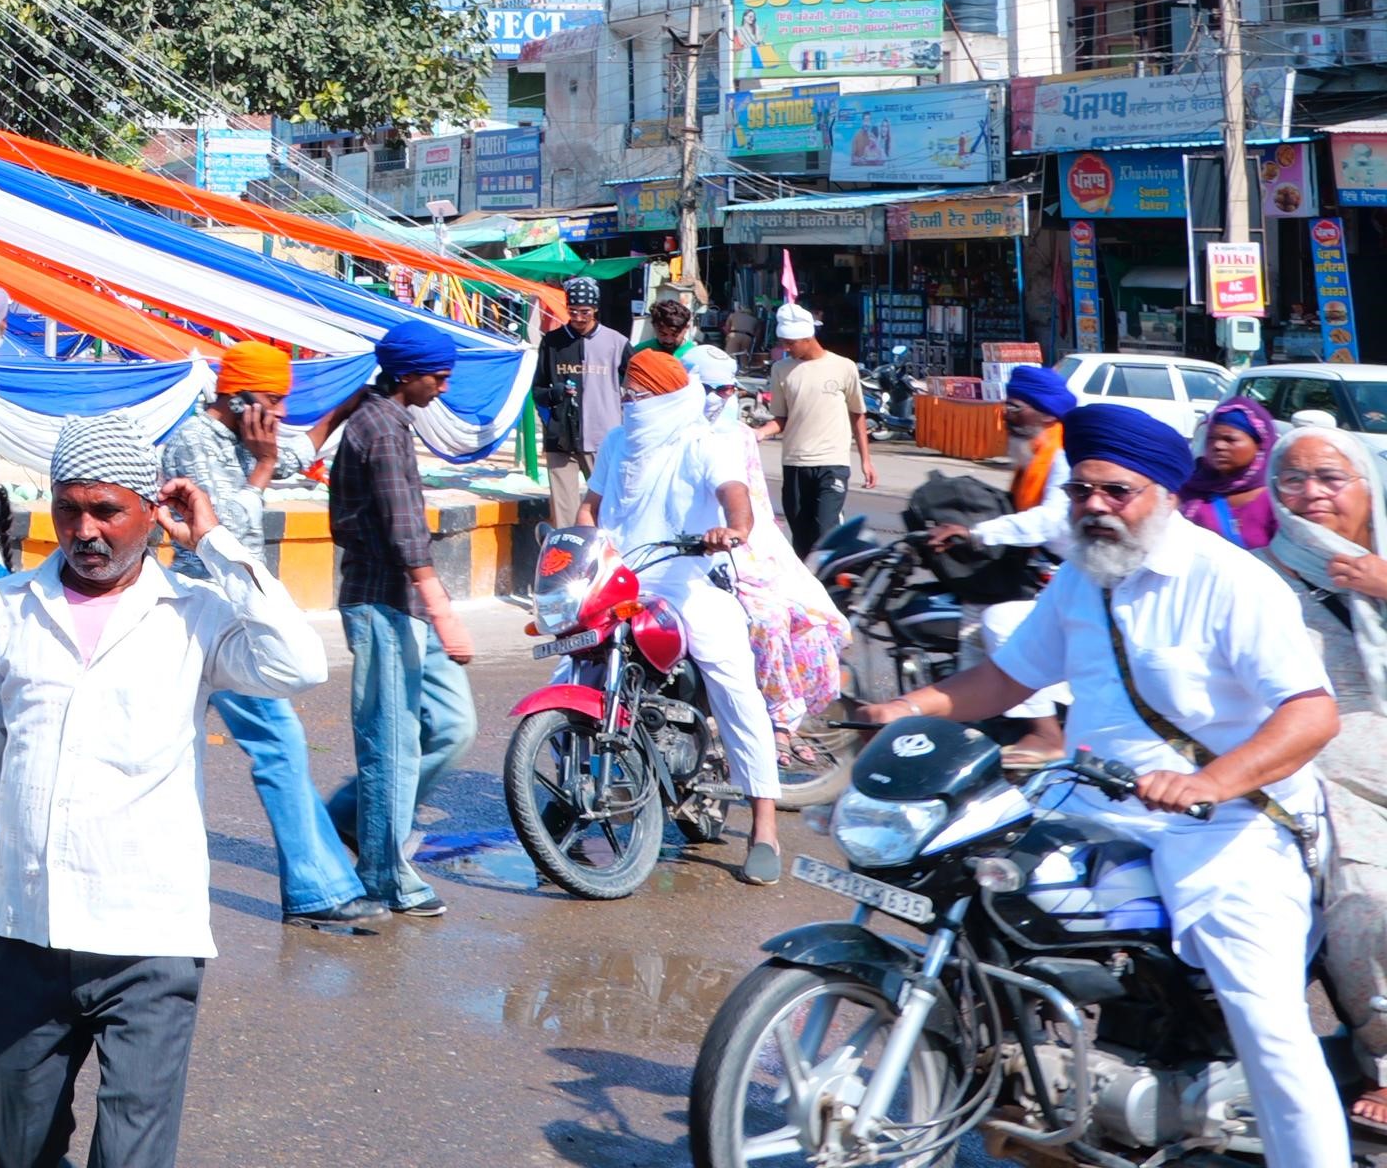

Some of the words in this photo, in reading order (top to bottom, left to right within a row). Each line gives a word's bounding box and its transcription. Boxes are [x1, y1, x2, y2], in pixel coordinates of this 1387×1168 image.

[1063, 86, 1129, 120] ਪੰਜਾਬ
[747, 103, 766, 130] 99
[767, 98, 815, 129] STORE
[1138, 186, 1170, 198] Sweets
[1139, 199, 1170, 212] Bakery
[1228, 280, 1244, 292] AC
